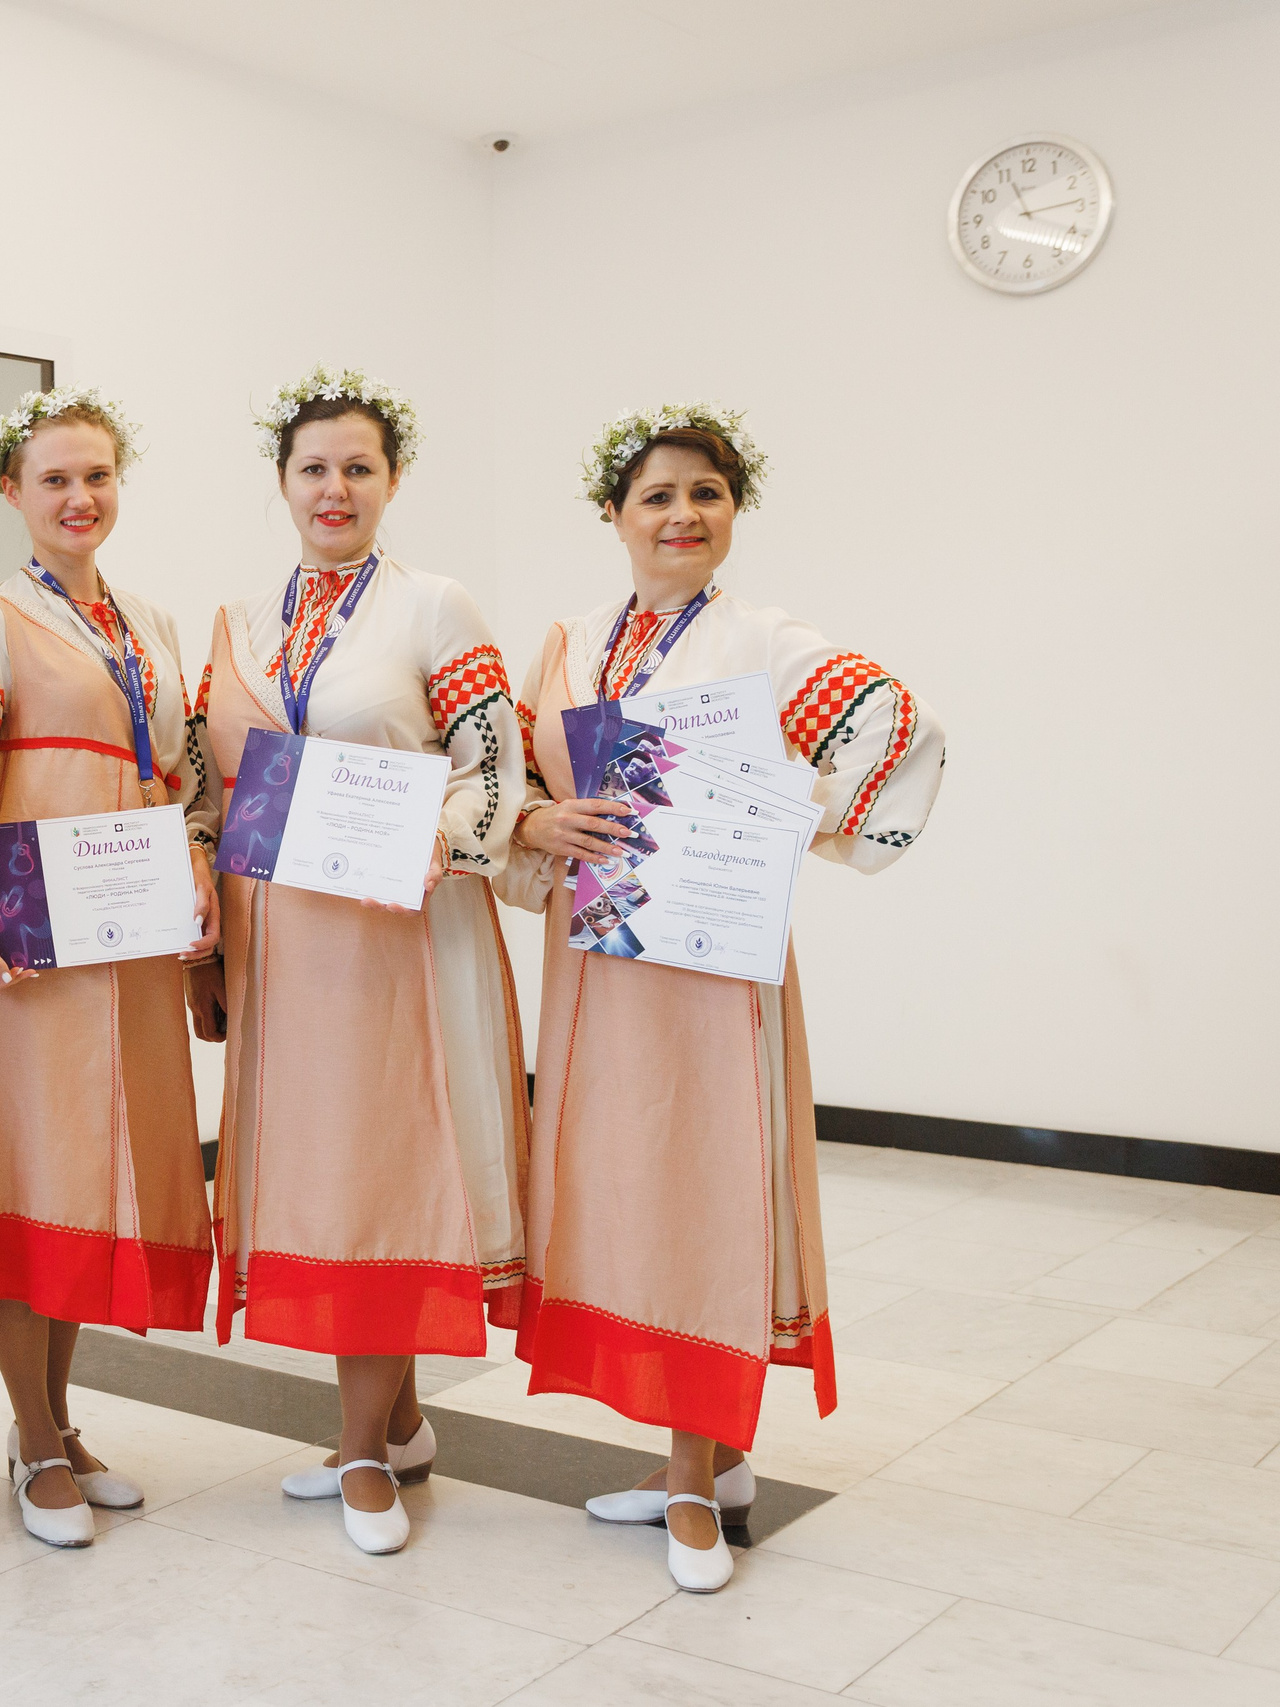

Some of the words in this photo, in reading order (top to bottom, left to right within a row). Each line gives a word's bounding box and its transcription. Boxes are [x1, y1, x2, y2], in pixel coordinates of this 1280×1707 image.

[1021, 157, 1036, 173] 12
[1051, 160, 1057, 175] 1
[998, 168, 1011, 184] 11
[1067, 175, 1077, 191] 2
[981, 188, 996, 204] 10
[1076, 198, 1085, 213] 3
[973, 214, 983, 229] 9
[1067, 224, 1077, 236] 4
[981, 235, 990, 249] 8
[998, 251, 1008, 266] 7
[1052, 246, 1062, 258] 5
[1023, 254, 1033, 268] 6
[129, 666, 141, 699] таланты!
[659, 707, 740, 731] Диплом
[331, 766, 409, 793] Диплом
[73, 837, 151, 857] Диплом
[681, 846, 766, 868] Благодарность
